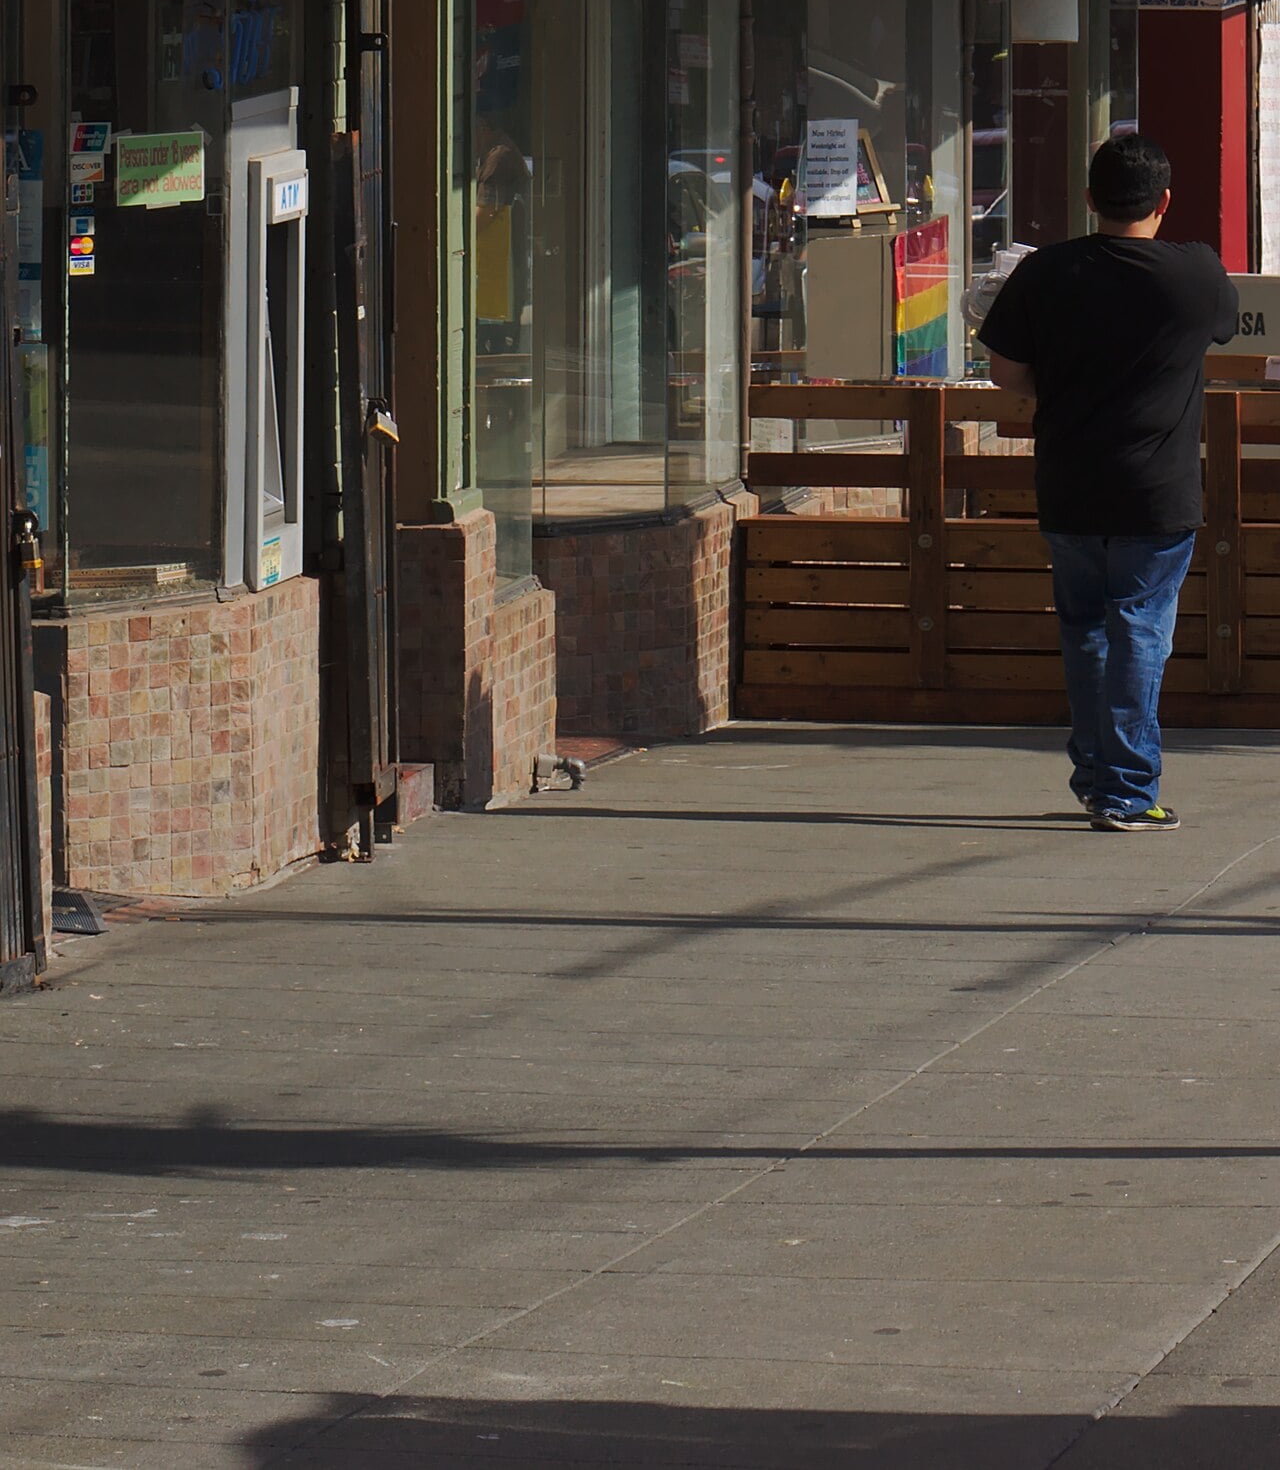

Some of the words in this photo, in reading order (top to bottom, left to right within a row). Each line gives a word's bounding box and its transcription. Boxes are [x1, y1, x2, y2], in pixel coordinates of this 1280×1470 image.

[72, 161, 102, 171] DISCOVER
[119, 143, 149, 169] Persons
[150, 142, 169, 167] under
[171, 140, 179, 164] 18
[180, 143, 201, 169] years
[120, 179, 139, 195] are
[141, 174, 160, 194] not
[162, 172, 202, 191] allowed
[281, 178, 299, 210] ATM
[73, 259, 92, 270] VISA
